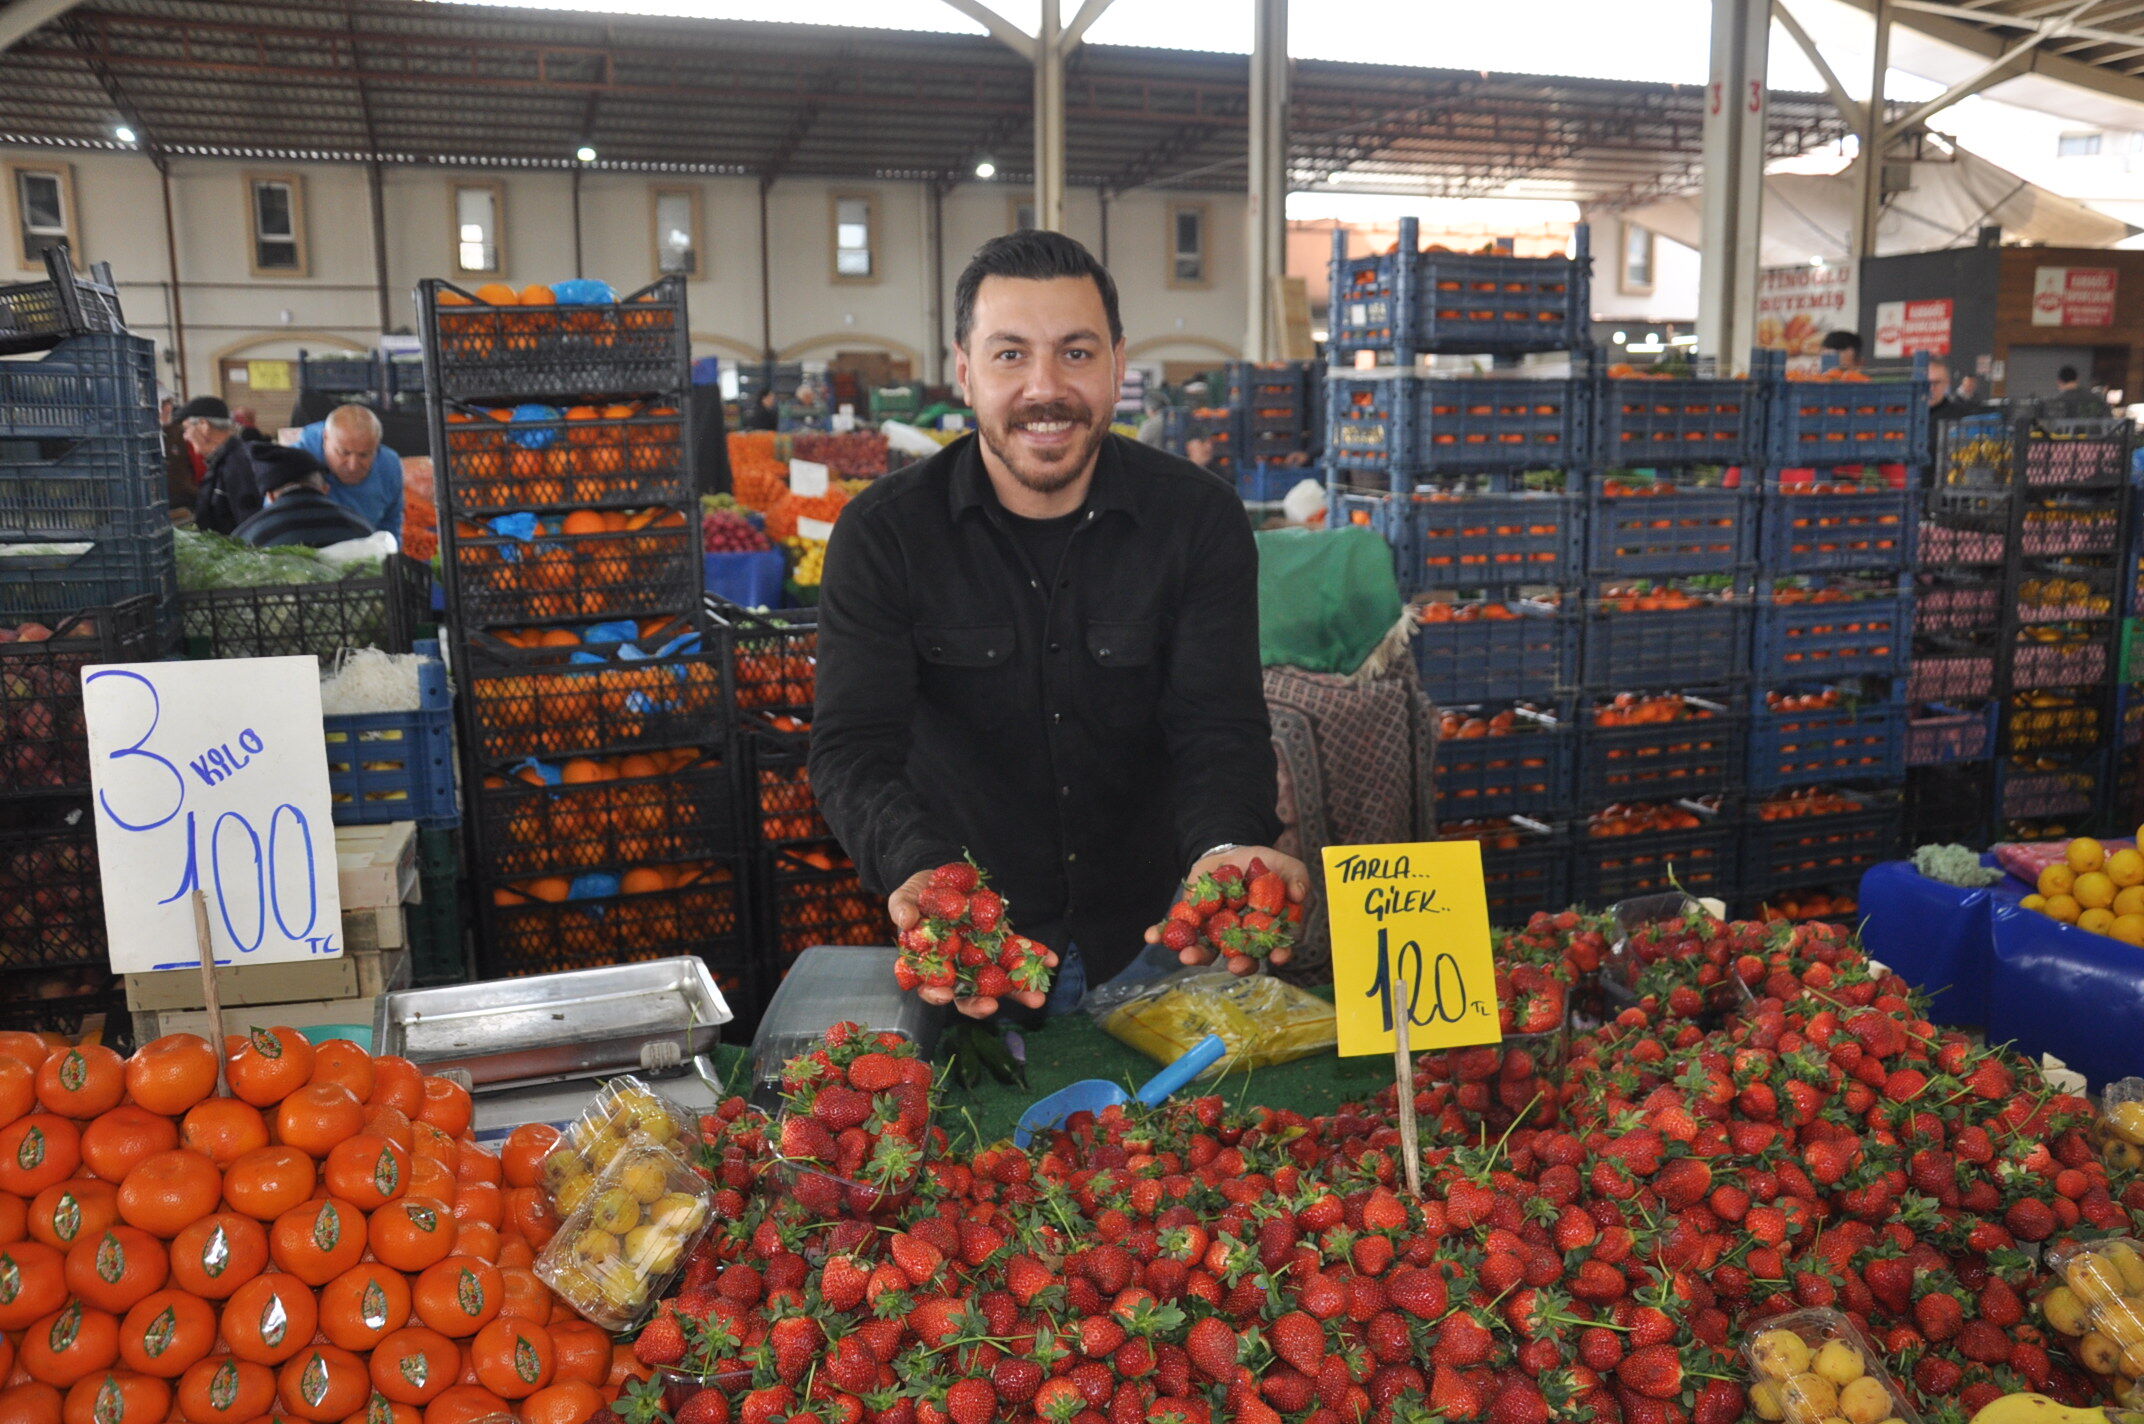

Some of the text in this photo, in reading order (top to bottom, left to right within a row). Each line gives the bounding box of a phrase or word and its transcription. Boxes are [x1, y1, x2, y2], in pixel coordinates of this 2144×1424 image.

[86, 670, 184, 831] 3
[158, 803, 317, 952] 100
[1365, 928, 1466, 1032] 120
[1470, 1000, 1490, 1016] TL
